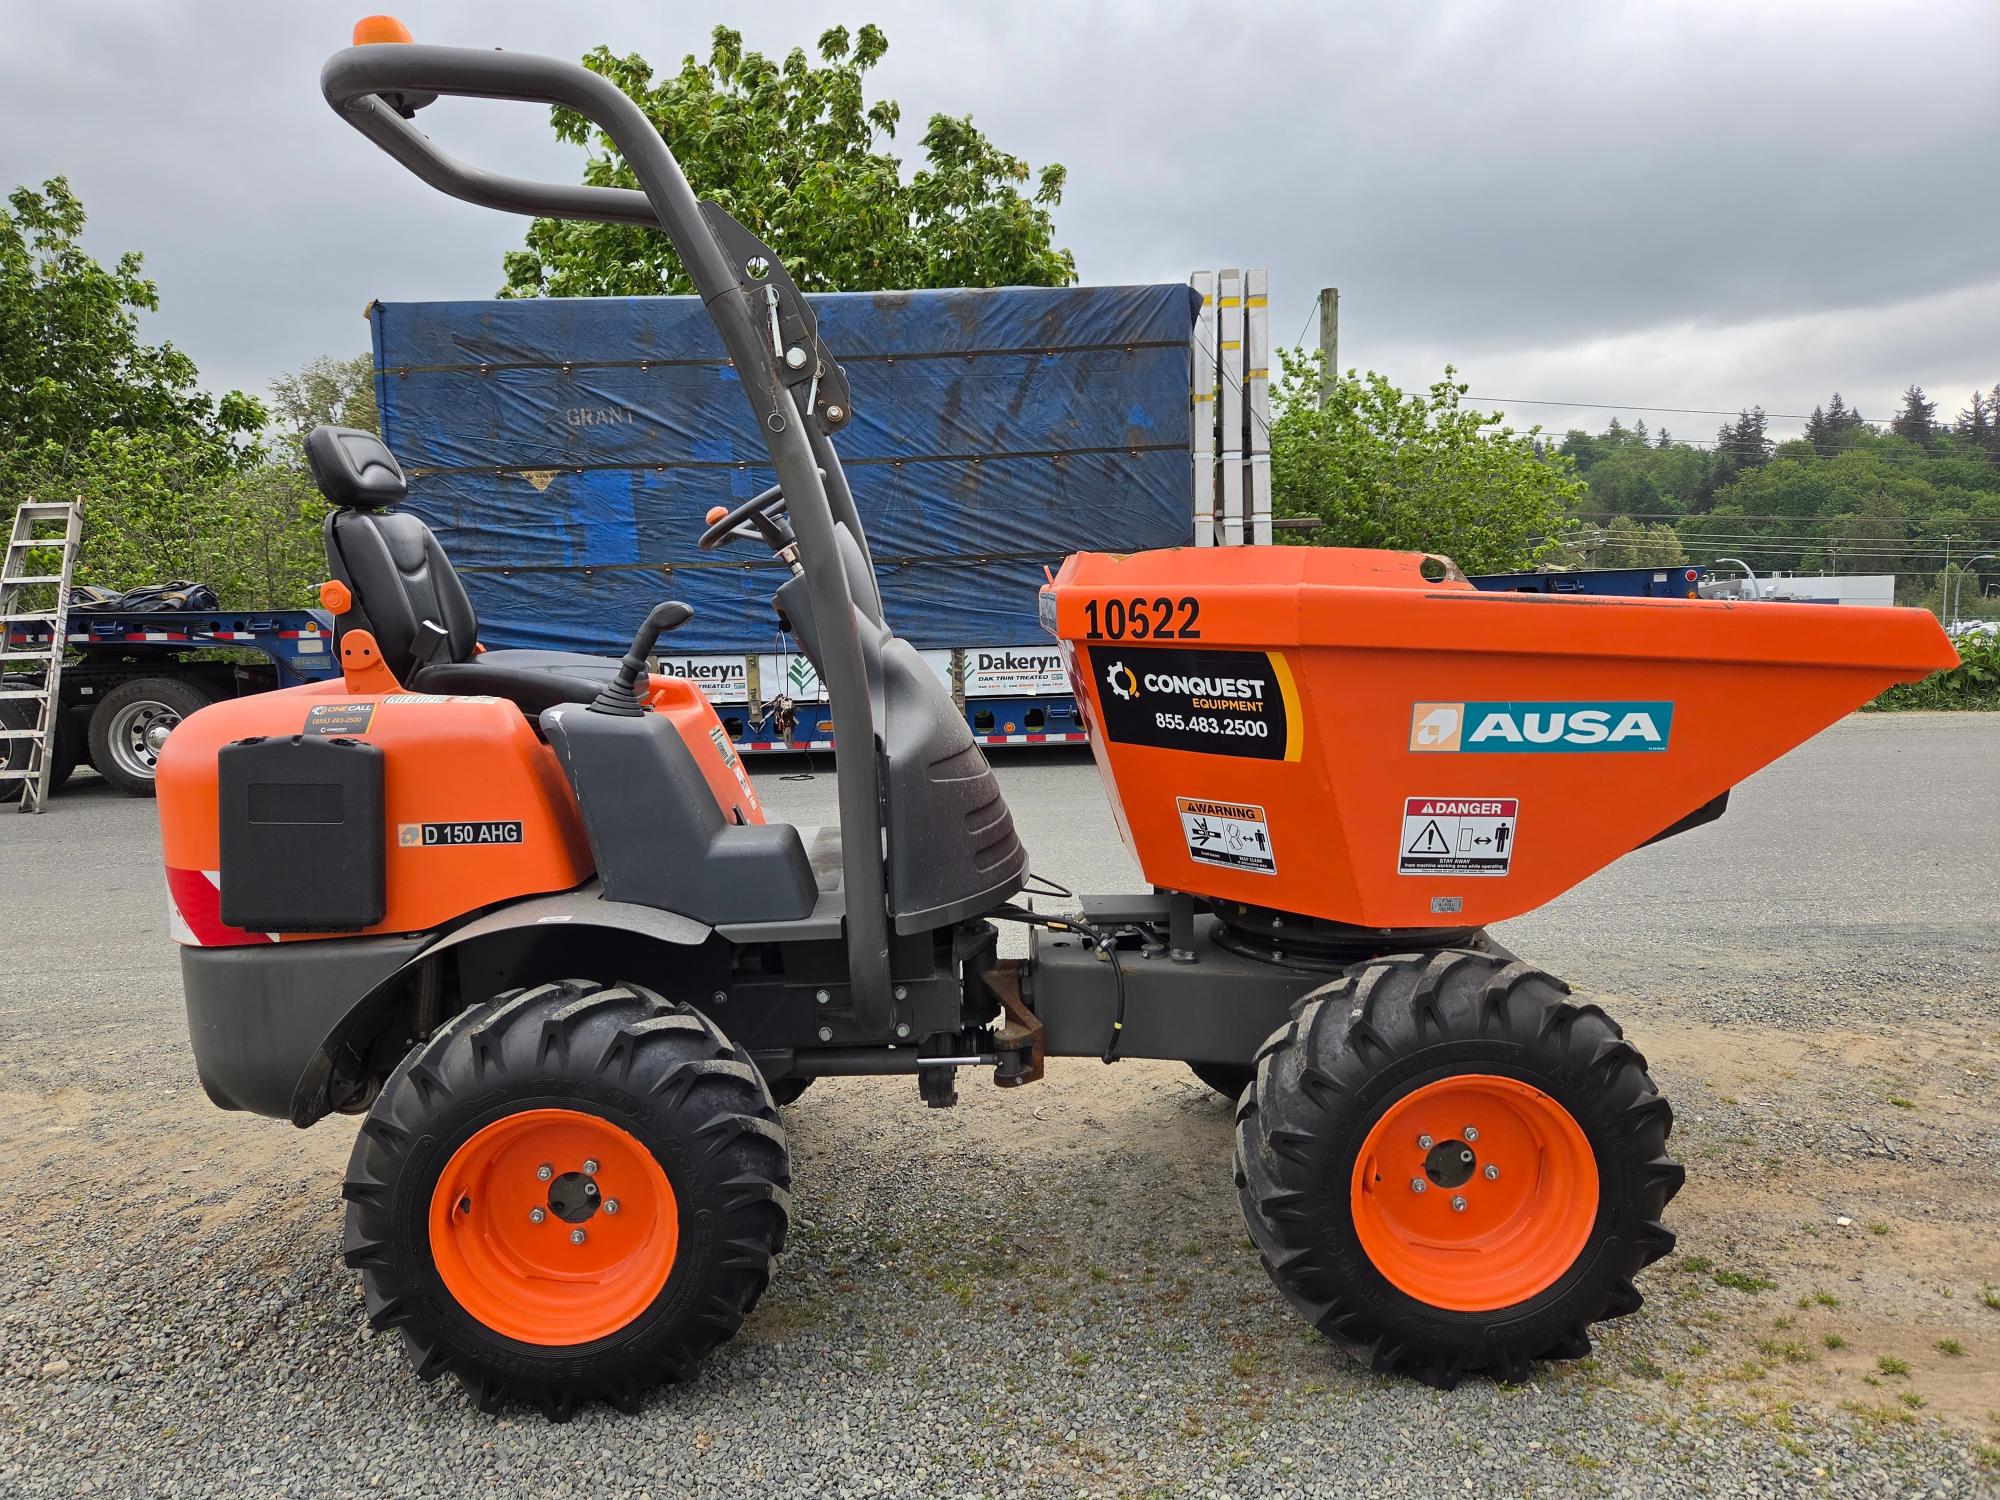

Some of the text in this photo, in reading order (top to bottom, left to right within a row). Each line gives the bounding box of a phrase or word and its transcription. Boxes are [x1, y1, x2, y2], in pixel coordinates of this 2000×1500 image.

[660, 660, 744, 683] Dakeryn
[978, 651, 1061, 674] Dakeryn
[1143, 673, 1265, 699] CONQUEST
[1192, 698, 1264, 712] EQUIPMENT
[1155, 712, 1268, 738] 855.483.2500
[1468, 710, 1662, 744] AUSA
[1195, 803, 1256, 819] WARNING
[1435, 803, 1502, 815] DANGER
[425, 824, 518, 844] D 150 AHG
